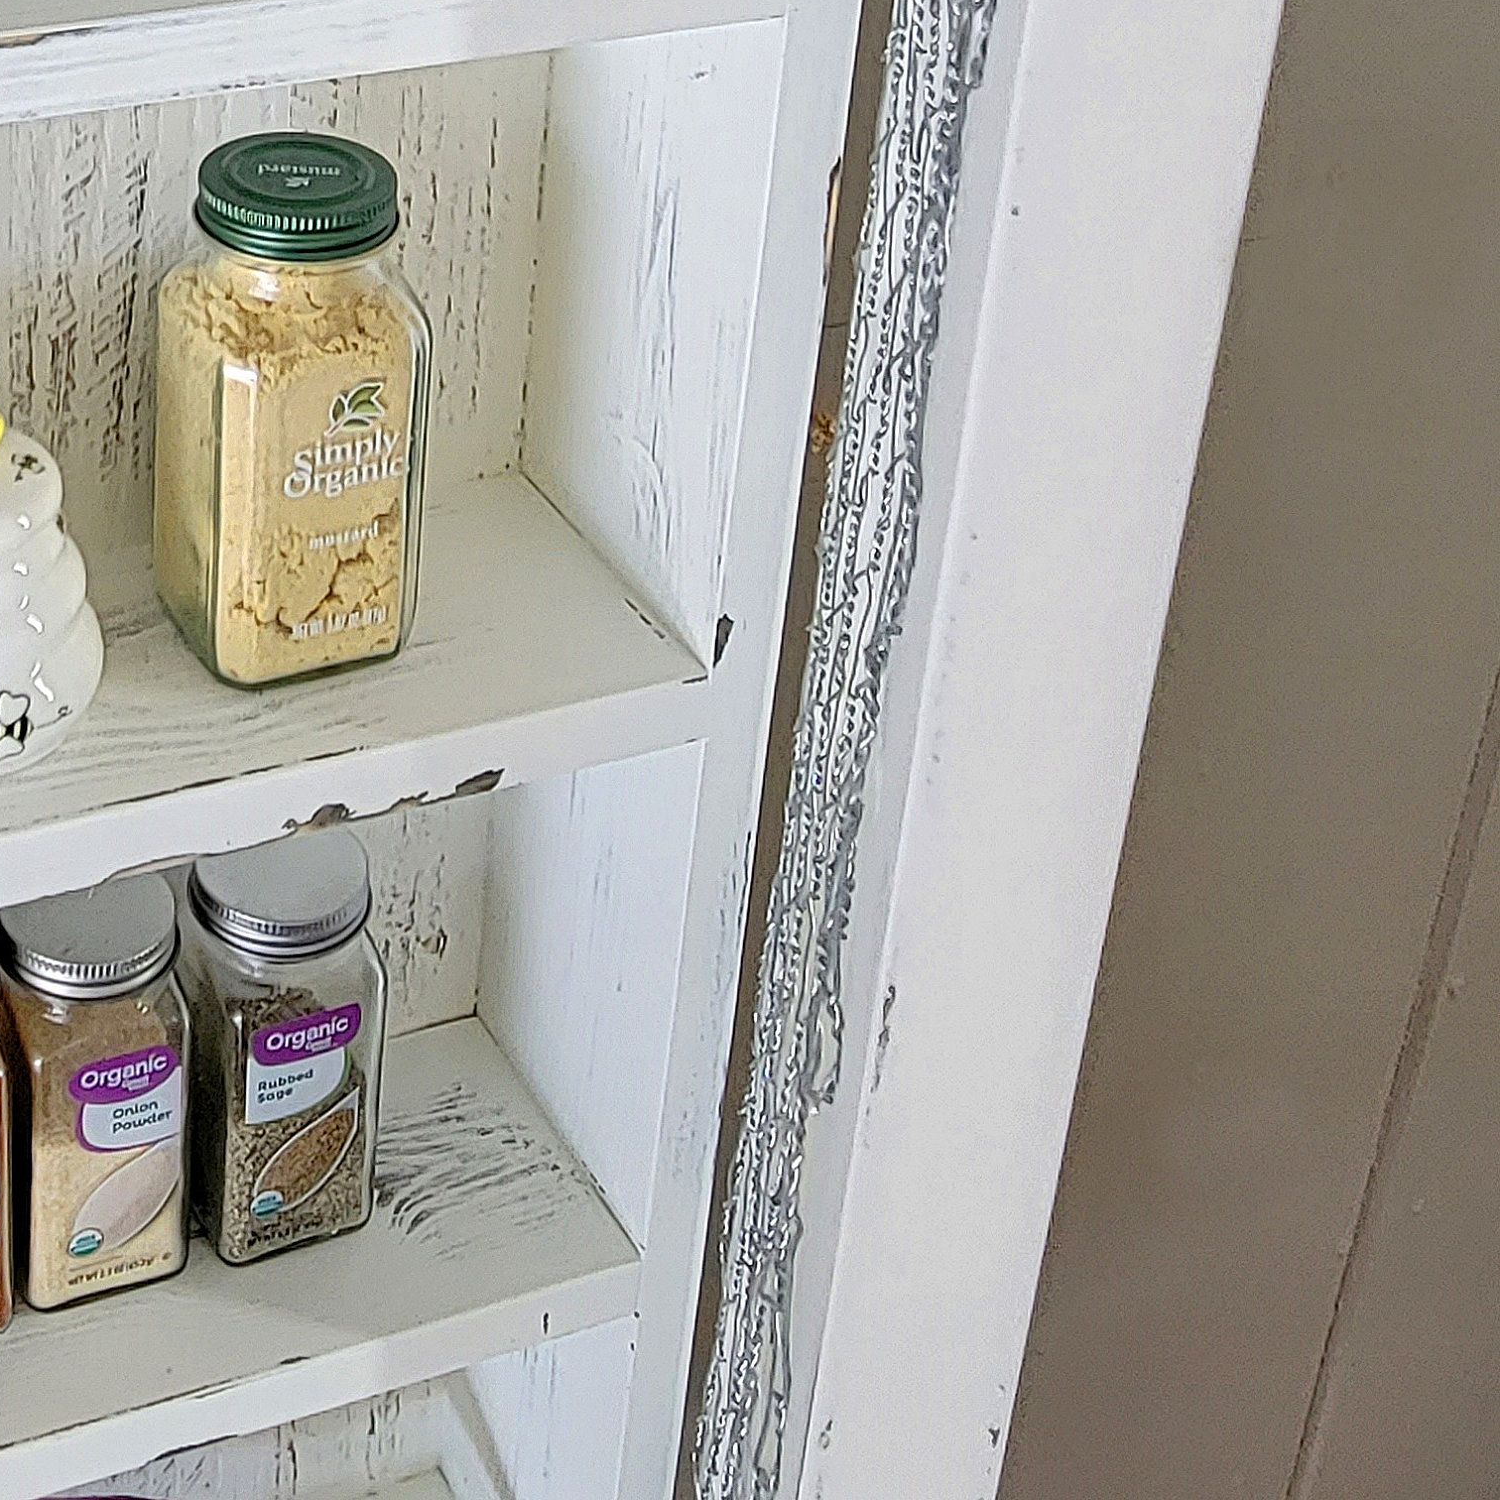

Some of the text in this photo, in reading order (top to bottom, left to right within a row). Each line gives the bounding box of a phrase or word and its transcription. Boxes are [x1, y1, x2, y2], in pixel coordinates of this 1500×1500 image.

[294, 428, 401, 476] Simply
[284, 455, 406, 498] Organic
[267, 1016, 349, 1051] Organic
[81, 1054, 167, 1088] Organic
[258, 1069, 314, 1091] Rubbed
[113, 1101, 159, 1119] Onion
[257, 1088, 293, 1104] Sage
[113, 1110, 172, 1134] Powder
